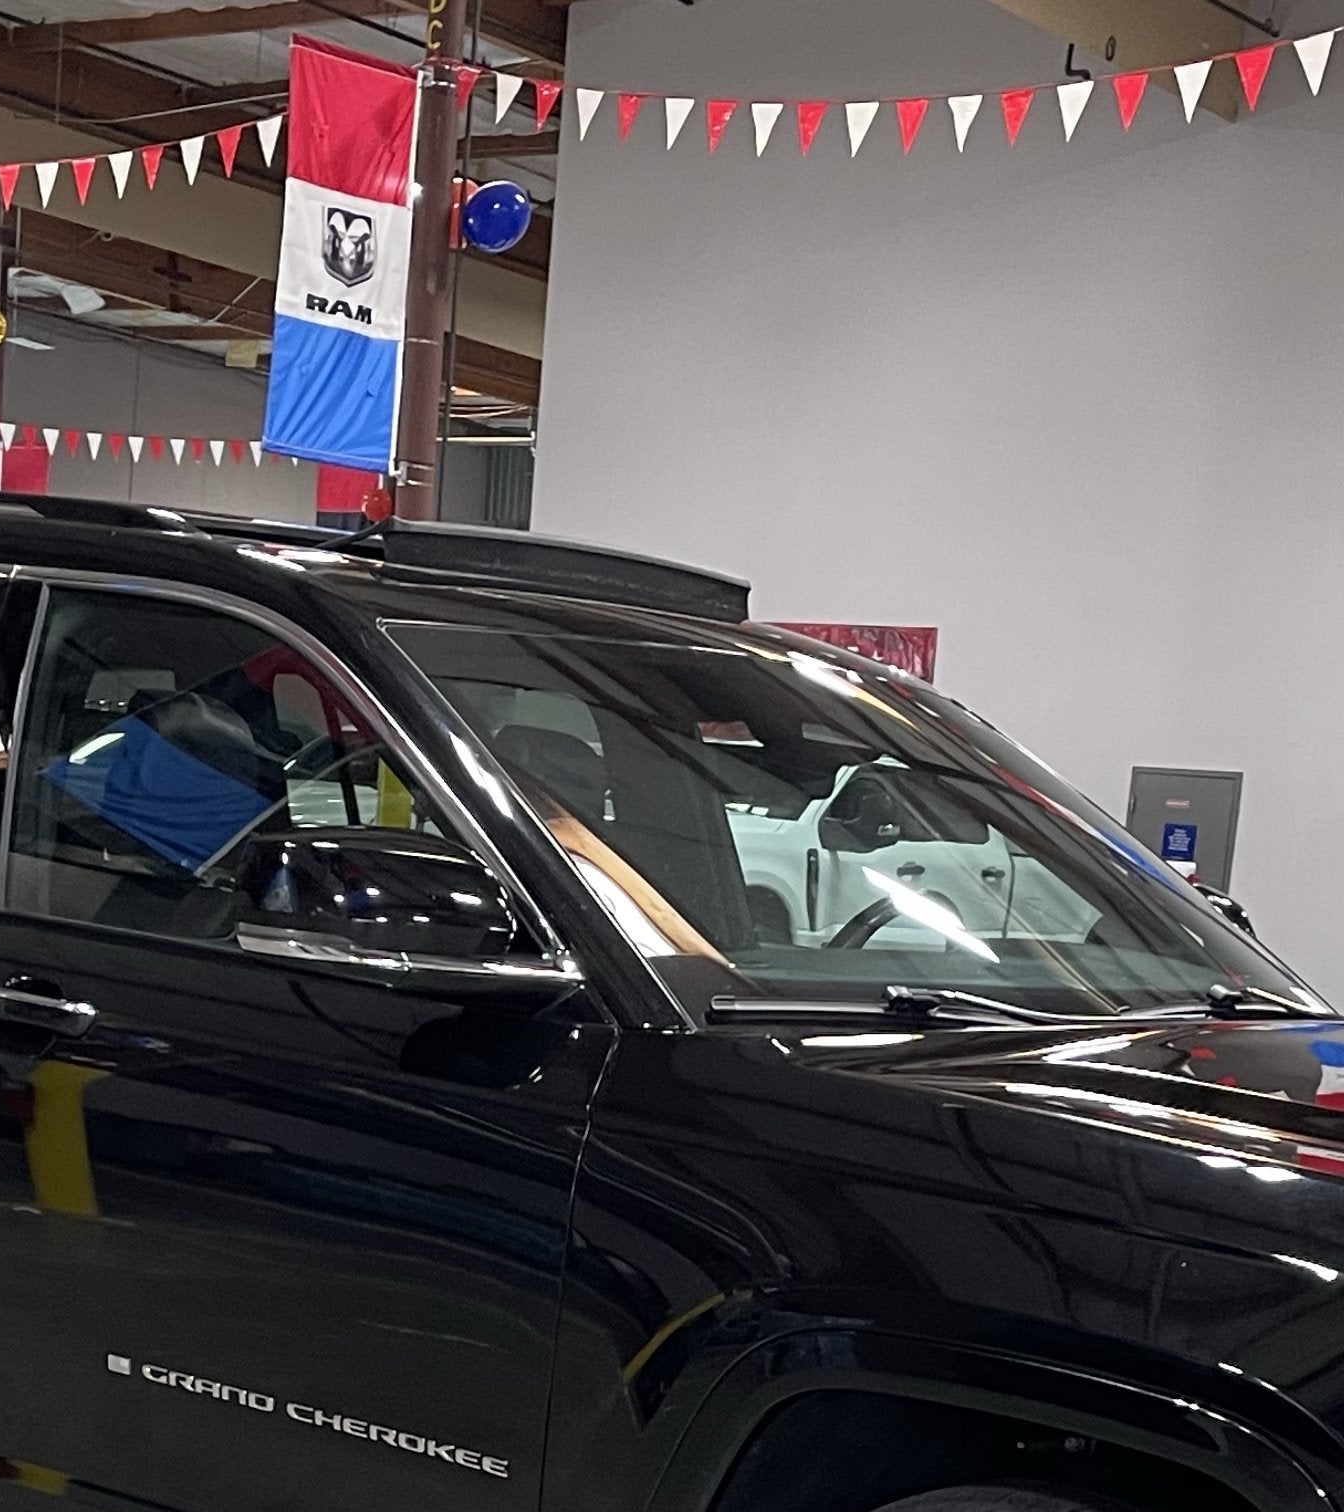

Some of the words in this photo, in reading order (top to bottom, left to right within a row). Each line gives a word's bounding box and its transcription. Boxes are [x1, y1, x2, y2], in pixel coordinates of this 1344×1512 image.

[306, 293, 372, 325] RAM
[141, 1363, 274, 1412] GRAND
[286, 1402, 509, 1478] CHEROKEE
